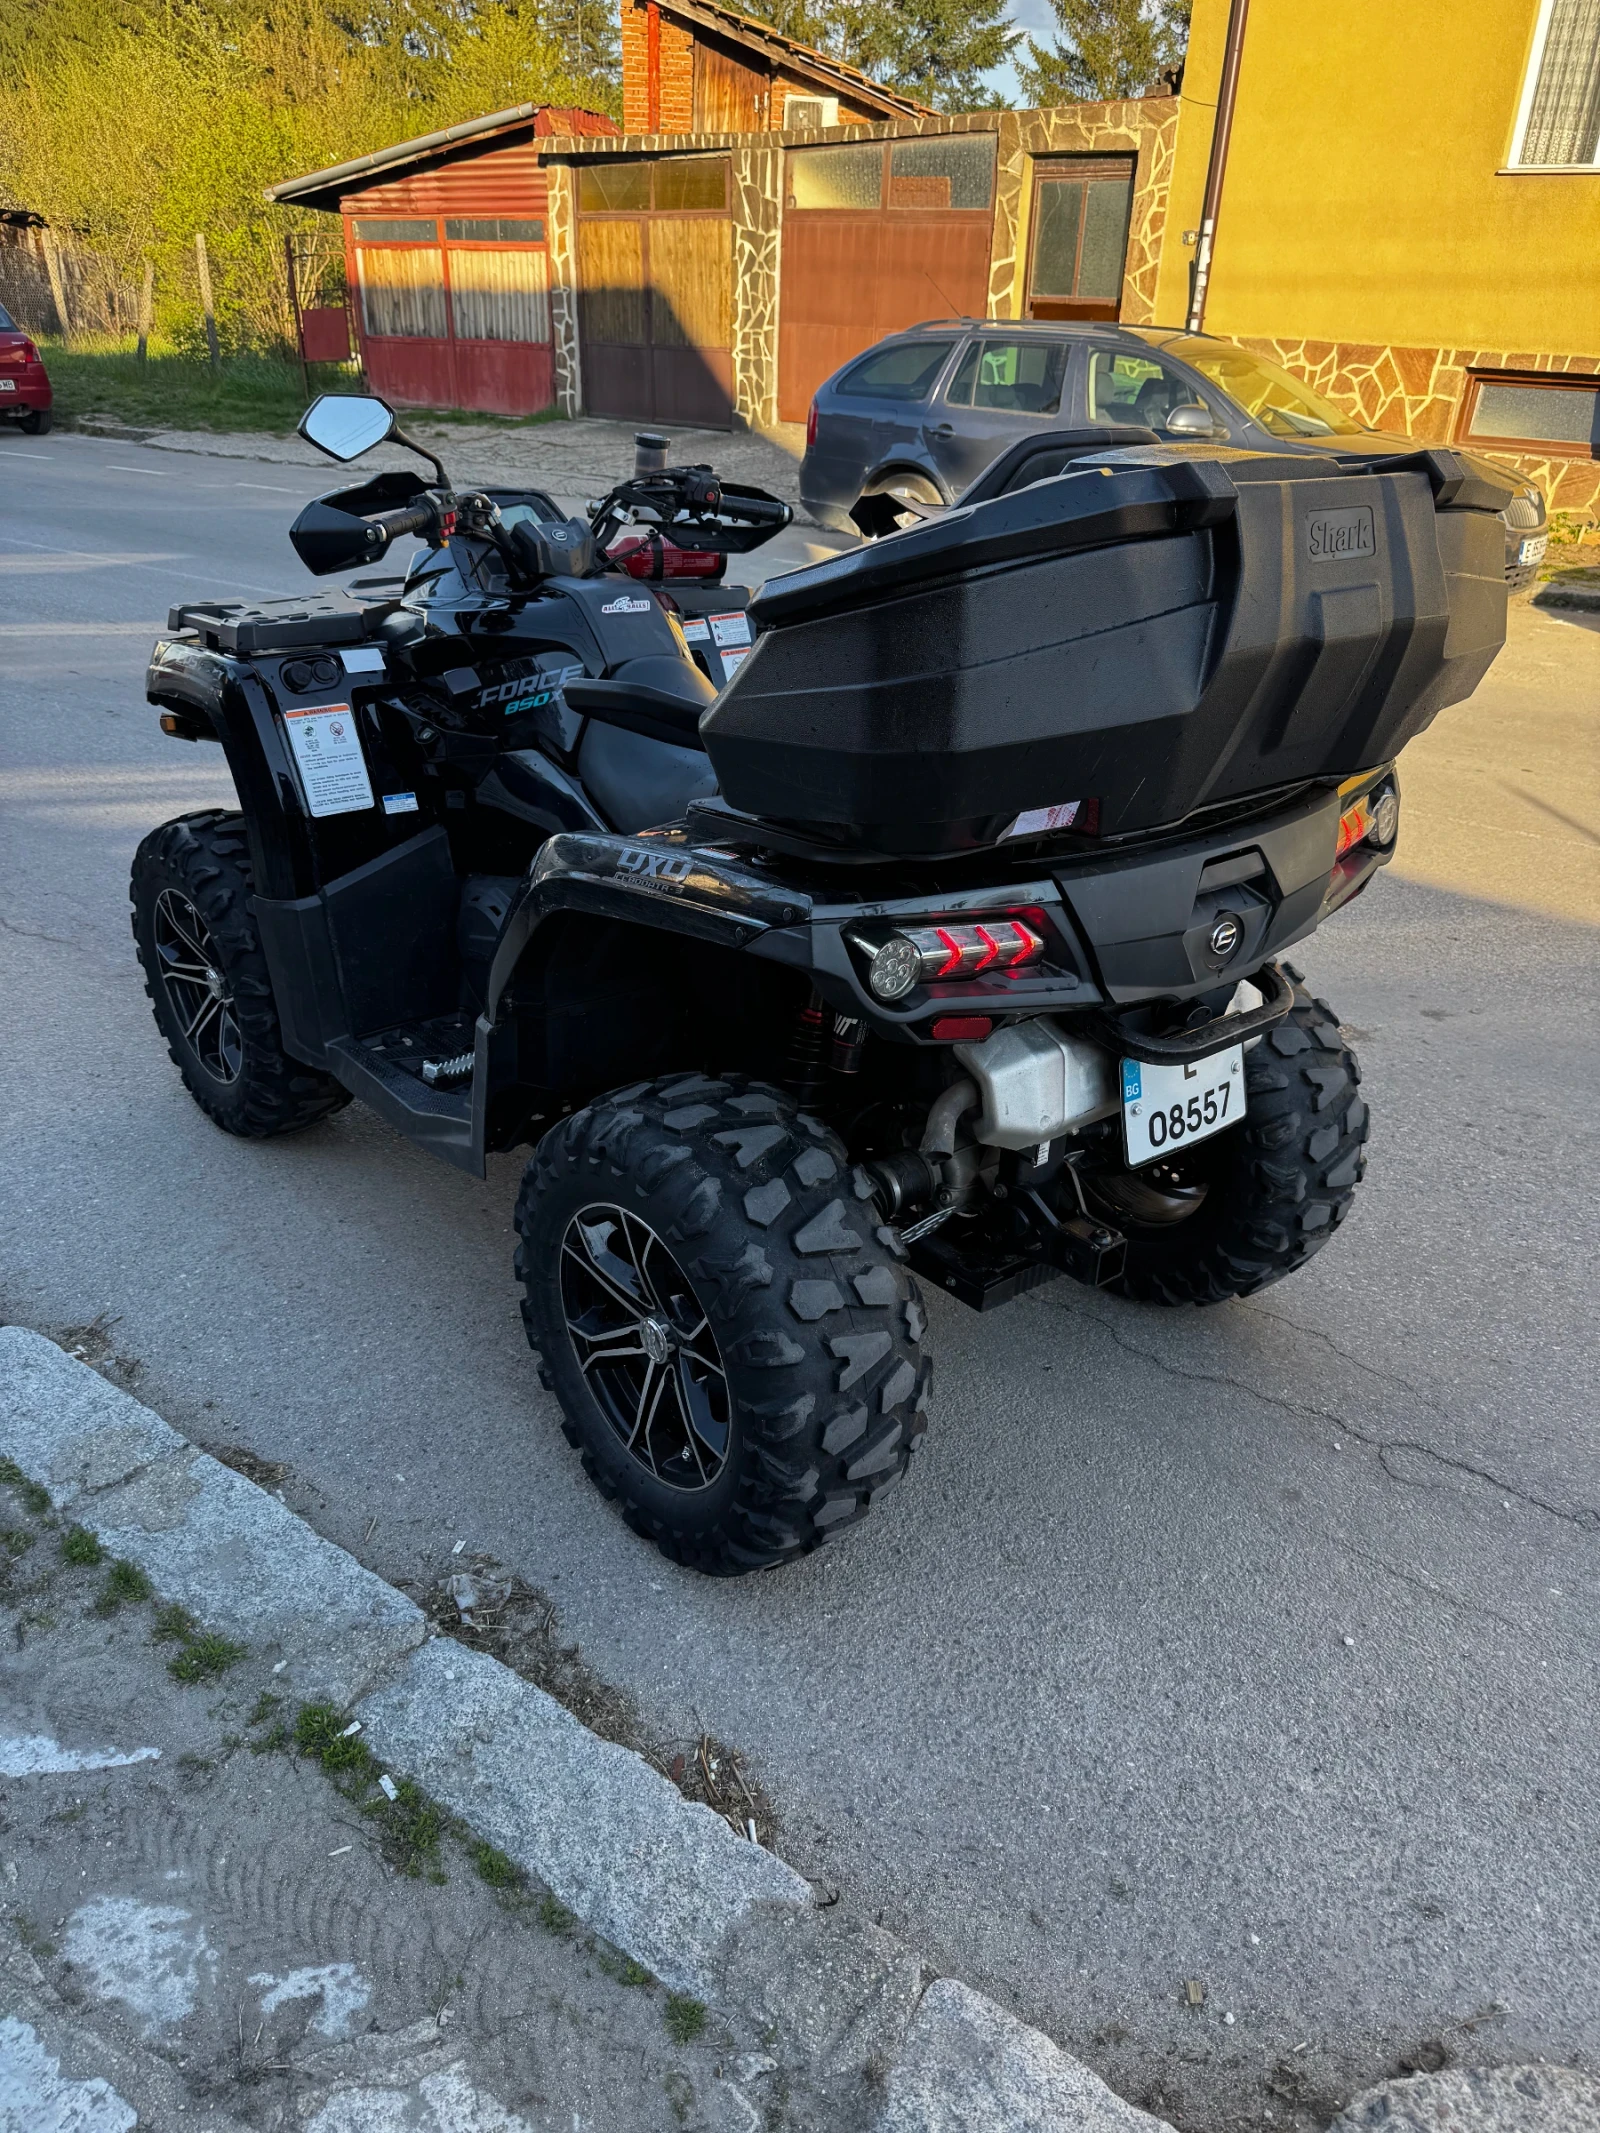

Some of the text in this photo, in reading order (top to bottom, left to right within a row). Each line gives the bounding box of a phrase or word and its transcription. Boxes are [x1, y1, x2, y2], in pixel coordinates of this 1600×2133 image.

[1309, 518, 1372, 557] Shark
[471, 663, 585, 710] FORCE
[1125, 1082, 1140, 1098] BG
[1148, 1080, 1231, 1148] 08557
